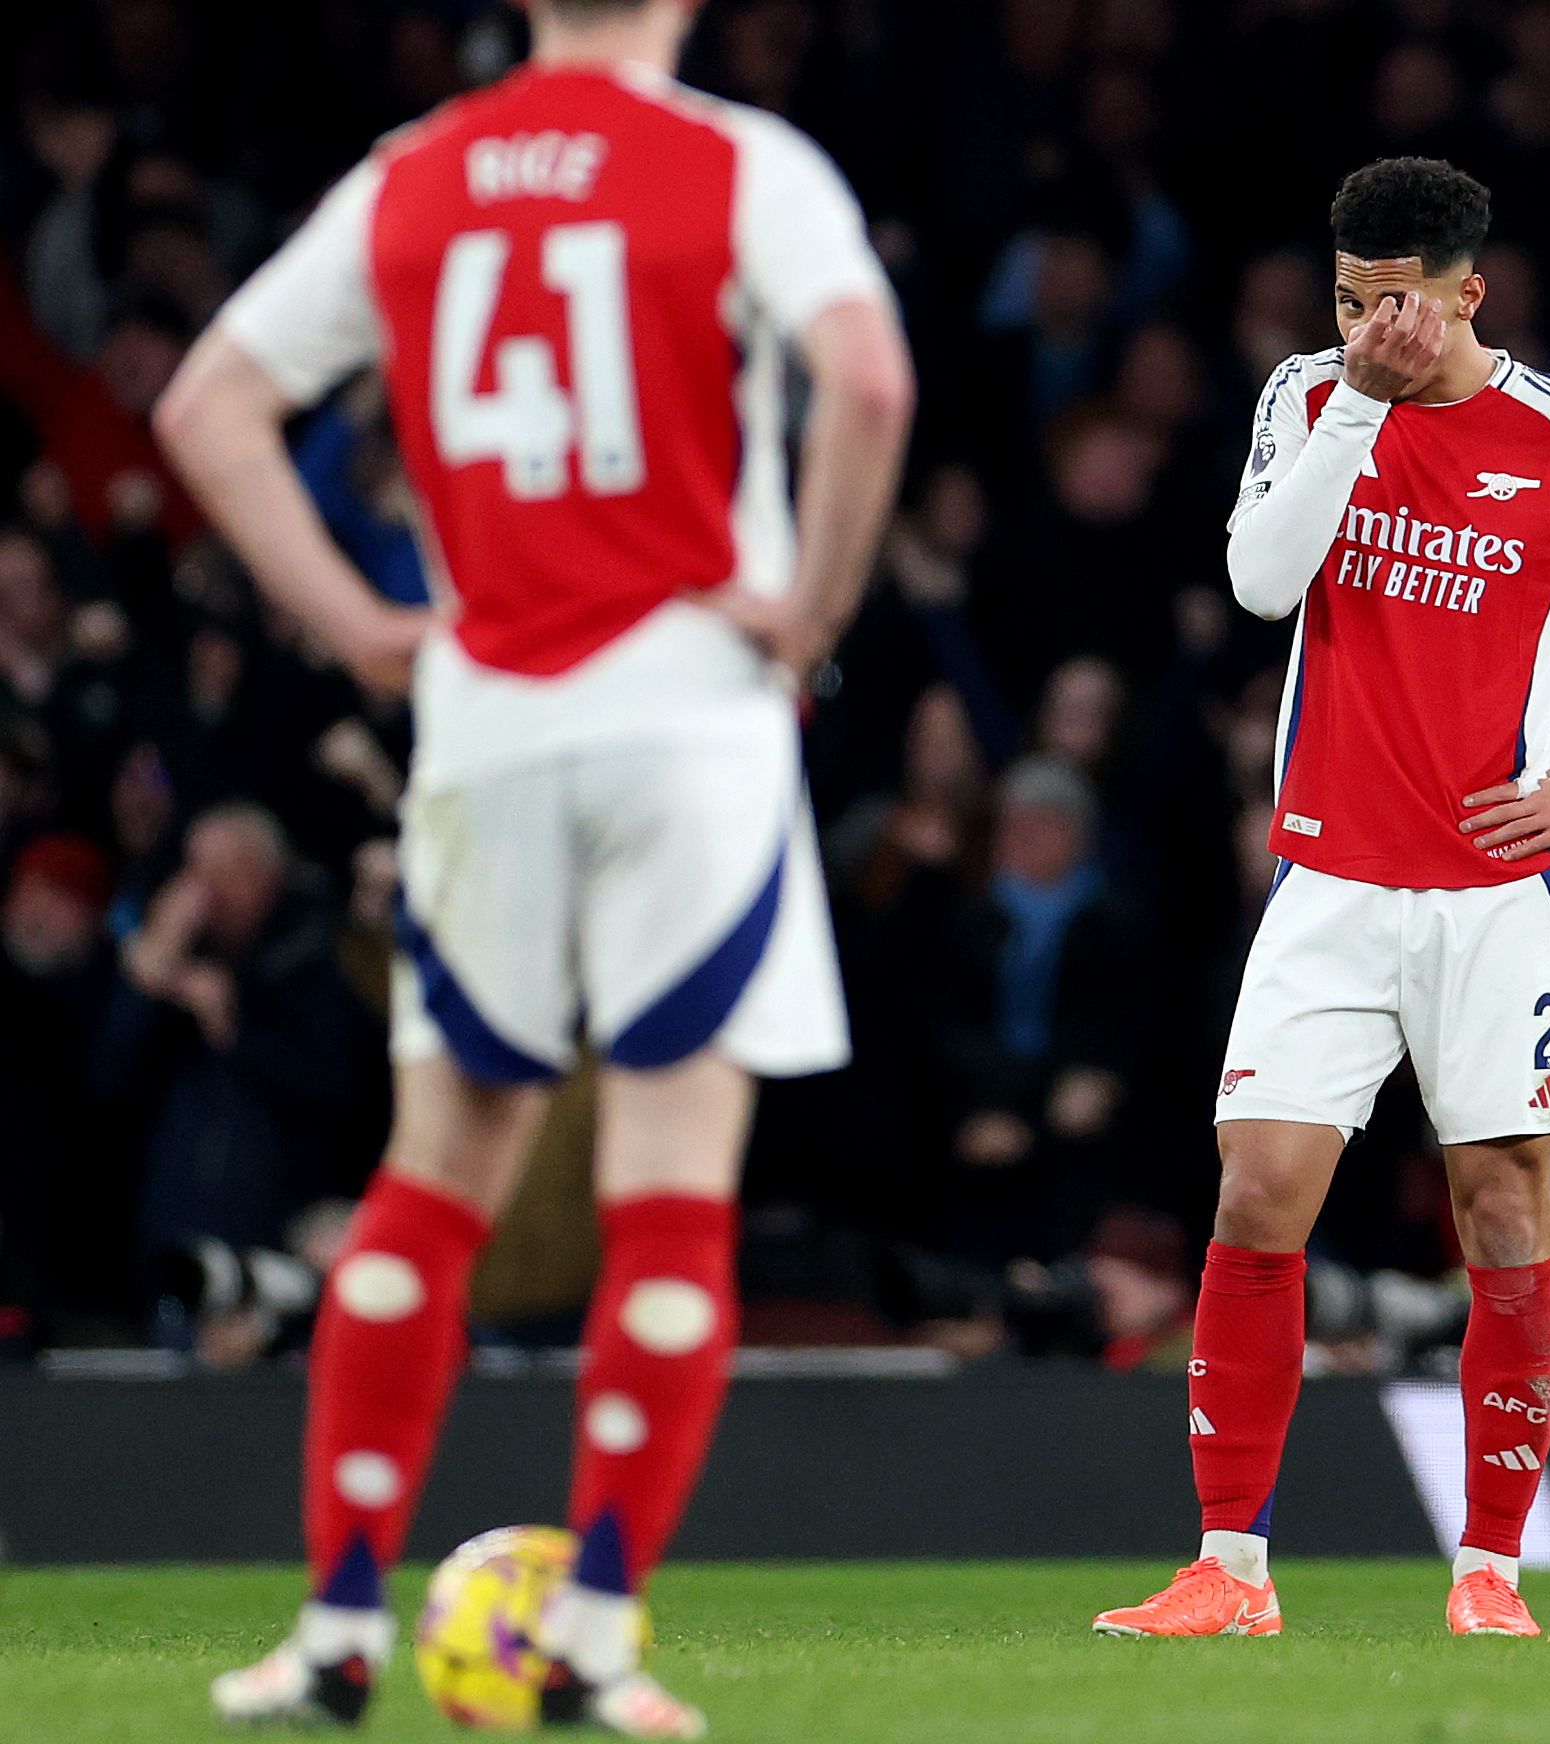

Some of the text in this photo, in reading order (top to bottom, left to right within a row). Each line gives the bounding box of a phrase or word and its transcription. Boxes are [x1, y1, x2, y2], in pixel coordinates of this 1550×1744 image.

[466, 131, 606, 206] RICE
[430, 221, 646, 498] 41
[1337, 504, 1525, 575] mirates
[1337, 549, 1486, 614] FLY BETTER
[1483, 1392, 1548, 1424] AFC
